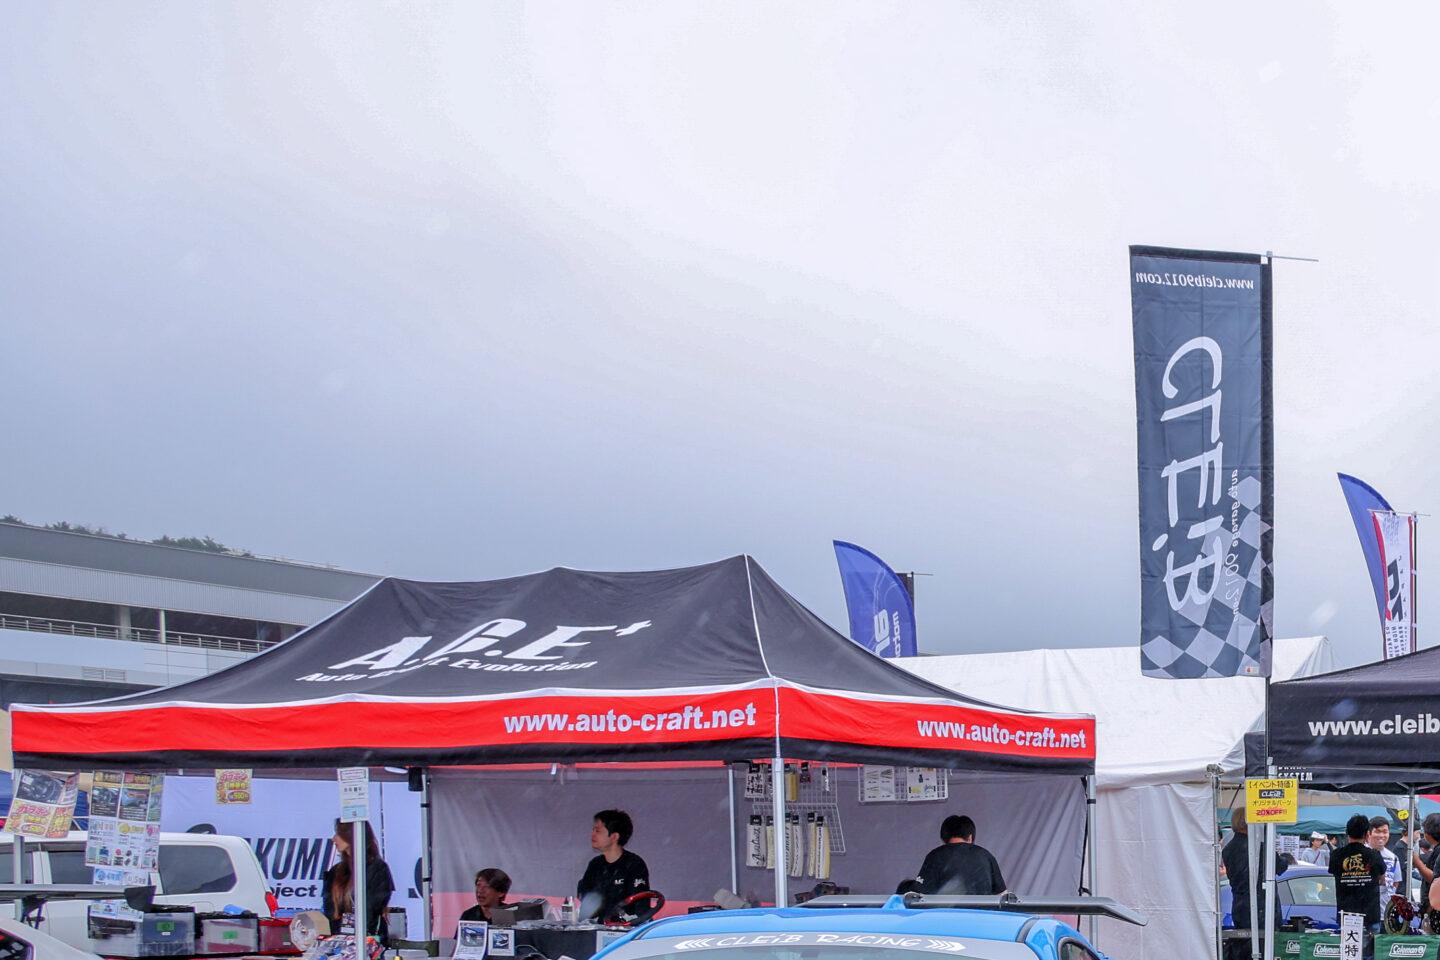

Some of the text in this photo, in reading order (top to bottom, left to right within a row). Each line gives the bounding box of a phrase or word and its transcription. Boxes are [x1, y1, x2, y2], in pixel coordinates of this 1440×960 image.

[448, 656, 598, 673] Evolution
[504, 701, 756, 734] www.auto-craft.net
[917, 719, 1087, 749] www.auto-craft.net
[816, 934, 921, 948] RACING
[1392, 945, 1420, 955] Coleman
